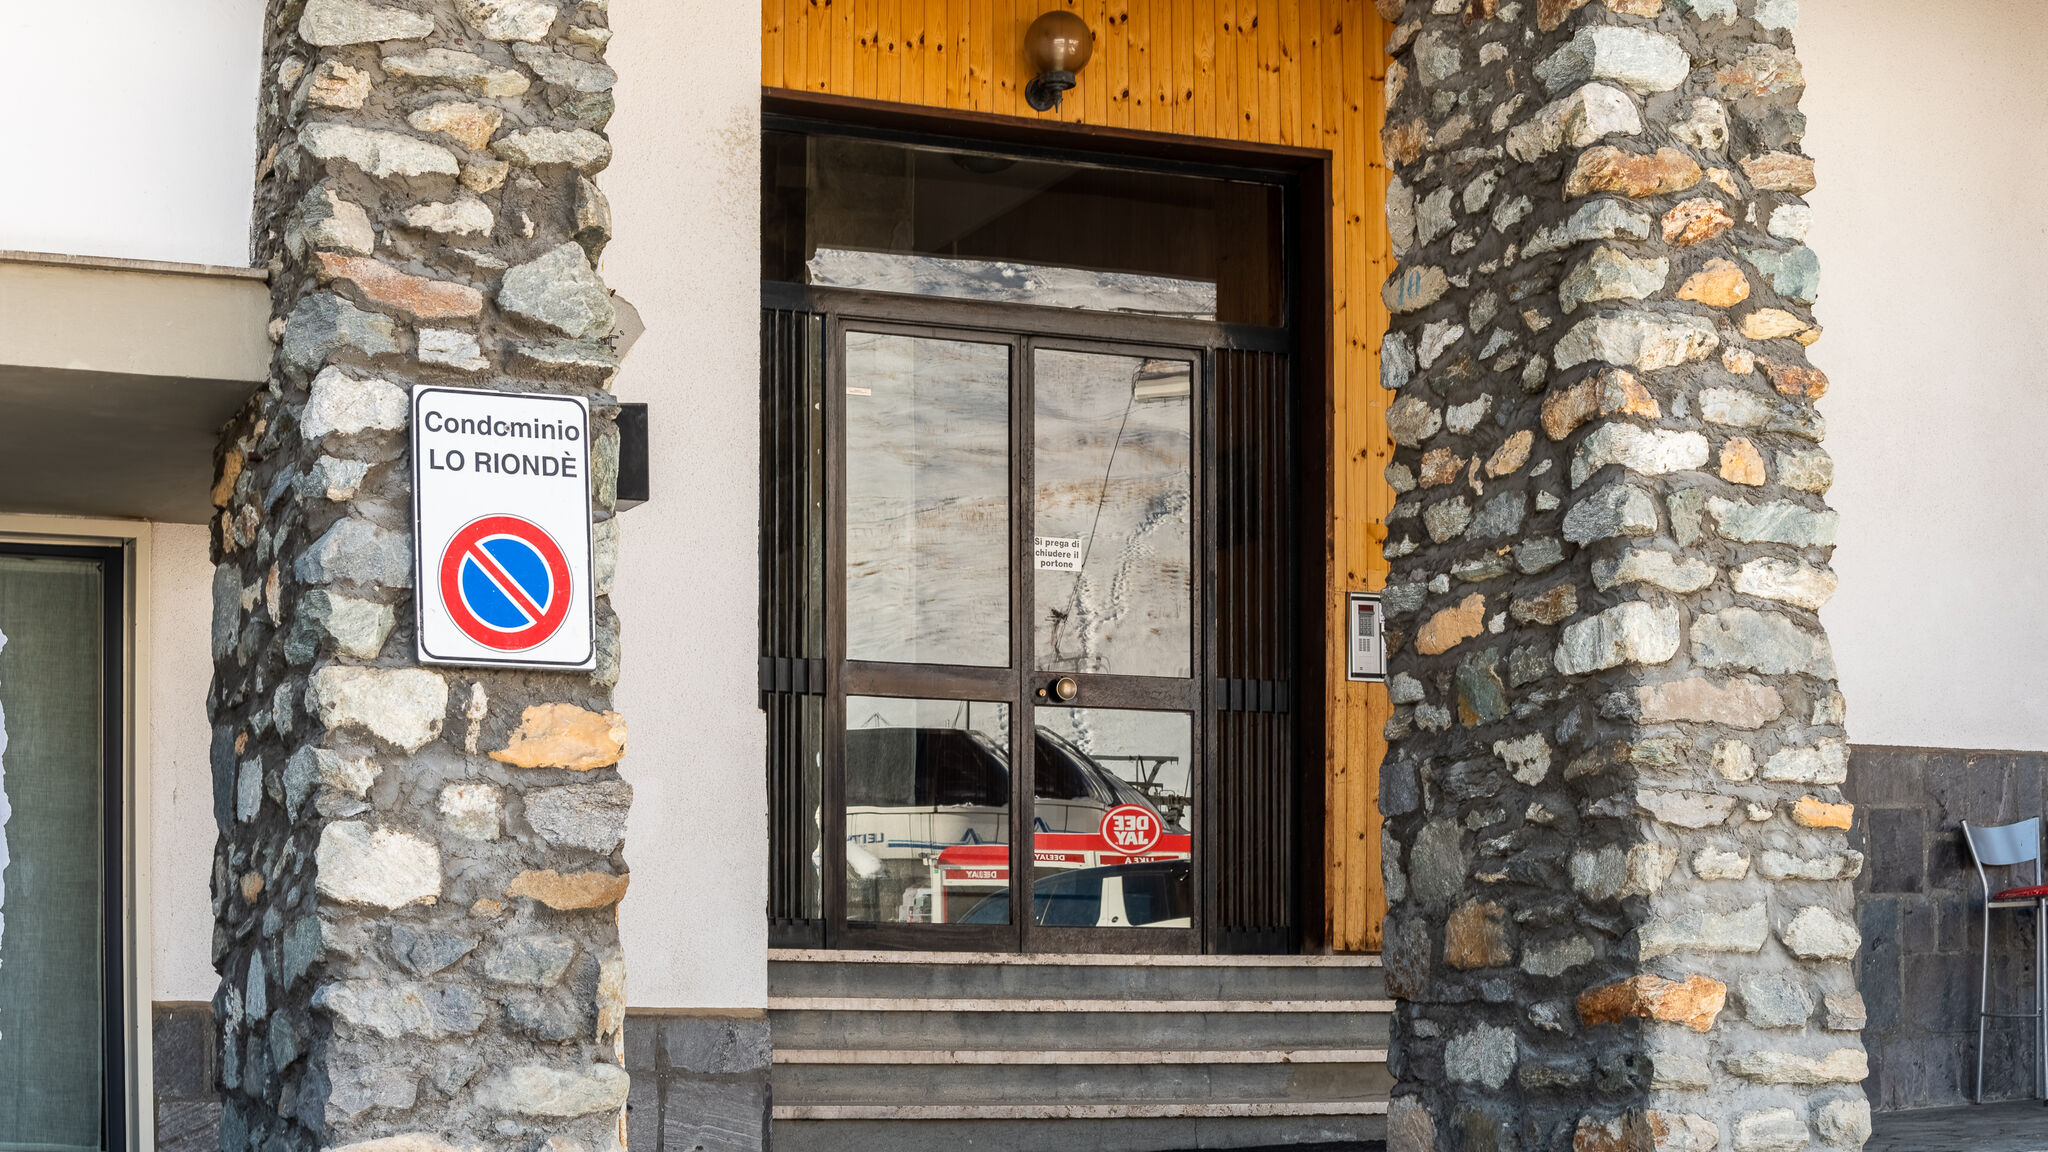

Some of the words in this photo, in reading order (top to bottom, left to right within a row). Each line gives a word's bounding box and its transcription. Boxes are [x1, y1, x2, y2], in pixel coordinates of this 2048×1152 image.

[425, 411, 580, 441] Condominio
[429, 449, 465, 471] LO
[475, 451, 578, 478] RIONDÈ
[1034, 538, 1043, 546] Si
[1045, 540, 1069, 549] prega
[1035, 549, 1071, 558] chiudere
[1073, 551, 1079, 559] il
[1040, 560, 1073, 568] portone
